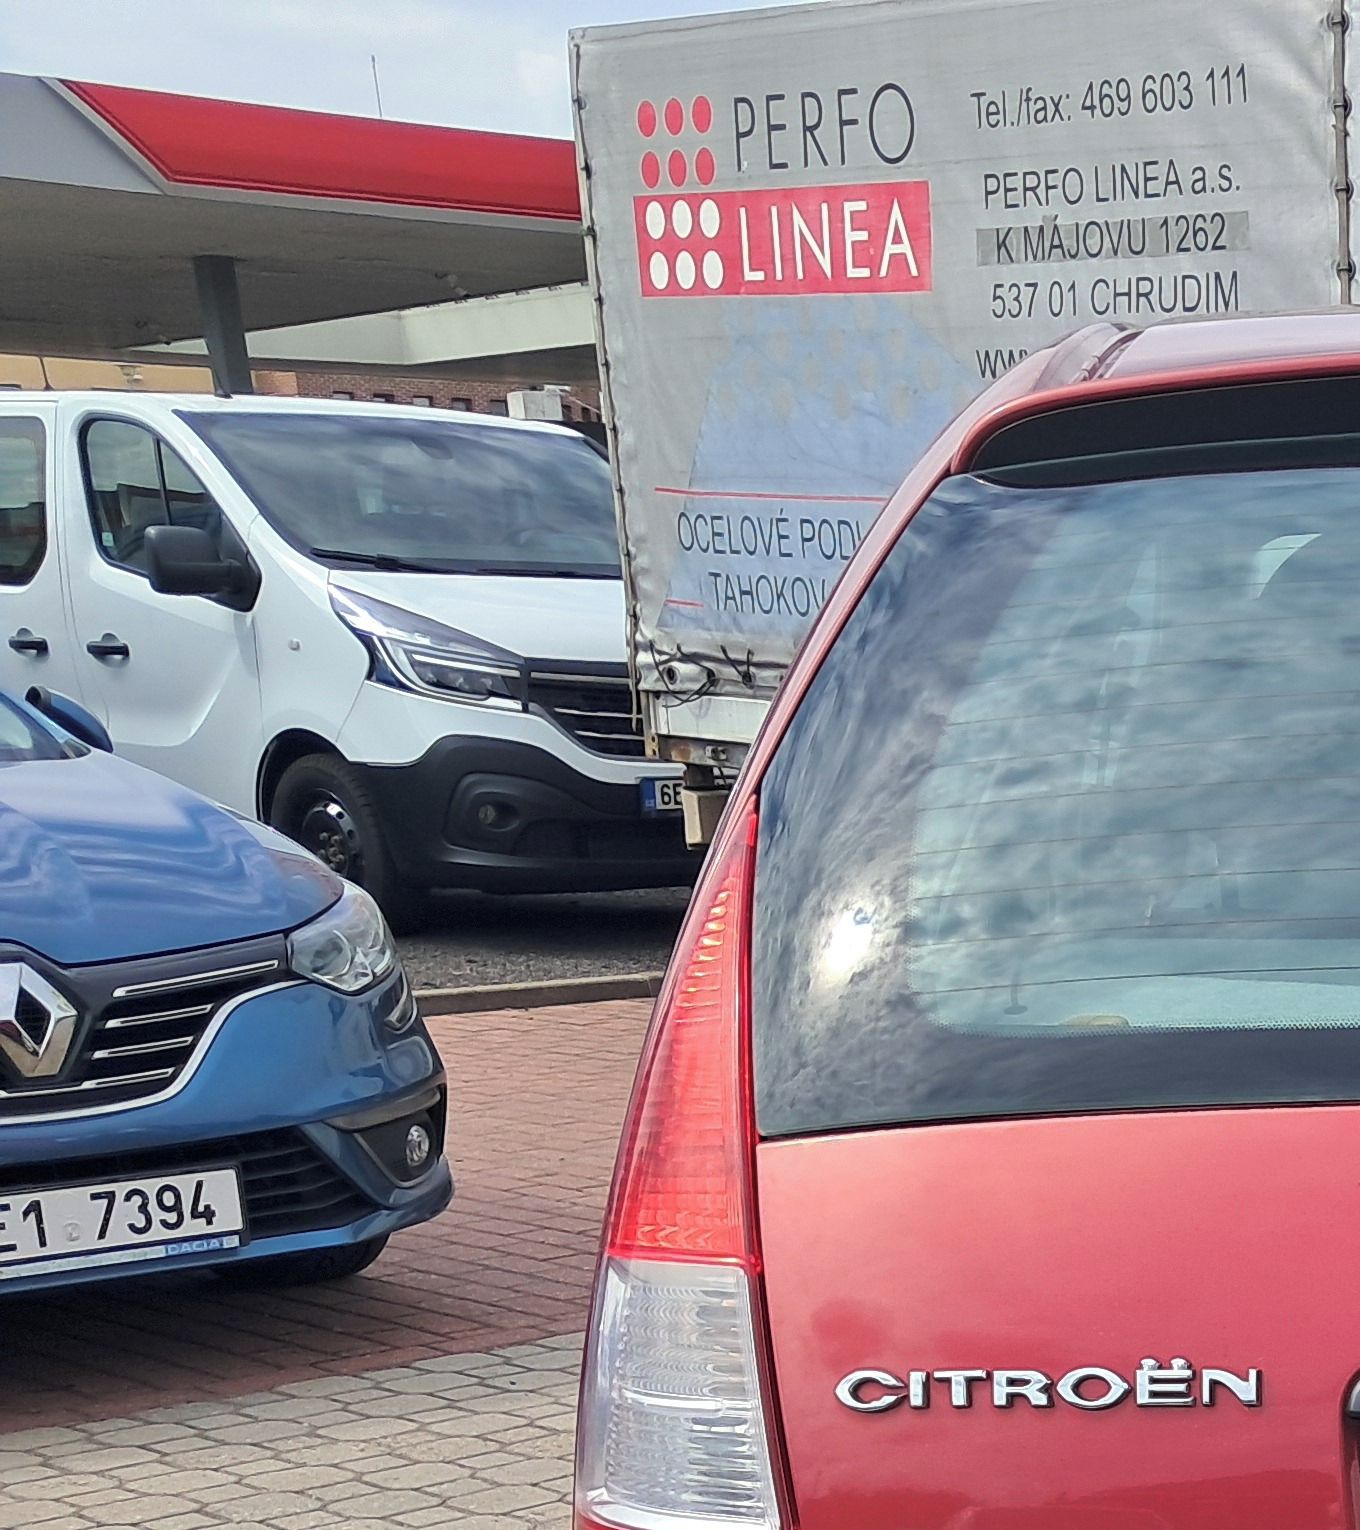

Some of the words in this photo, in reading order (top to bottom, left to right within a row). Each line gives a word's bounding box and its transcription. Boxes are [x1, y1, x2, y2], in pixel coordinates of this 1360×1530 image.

[970, 86, 1072, 129] Tel./fax:
[1081, 77, 1132, 119] 469
[1141, 70, 1193, 113] 603
[1206, 62, 1247, 106] 111
[733, 82, 915, 172] PERFO
[983, 167, 1084, 209] PERFO
[1095, 158, 1183, 203] LINEA
[1191, 163, 1240, 195] a.s.
[738, 197, 919, 281] LINEA
[996, 226, 1014, 264] K
[1023, 213, 1146, 262] MÁJOVU
[1159, 212, 1227, 254] 1262
[991, 281, 1039, 319] 537
[1048, 280, 1077, 318] 01
[1090, 270, 1239, 316] CHRUDIM
[677, 507, 793, 558] OCELOVÉ
[90, 1179, 217, 1241] 7394
[167, 1238, 220, 1256] DACIA
[833, 1357, 1262, 1412] CITROËN
